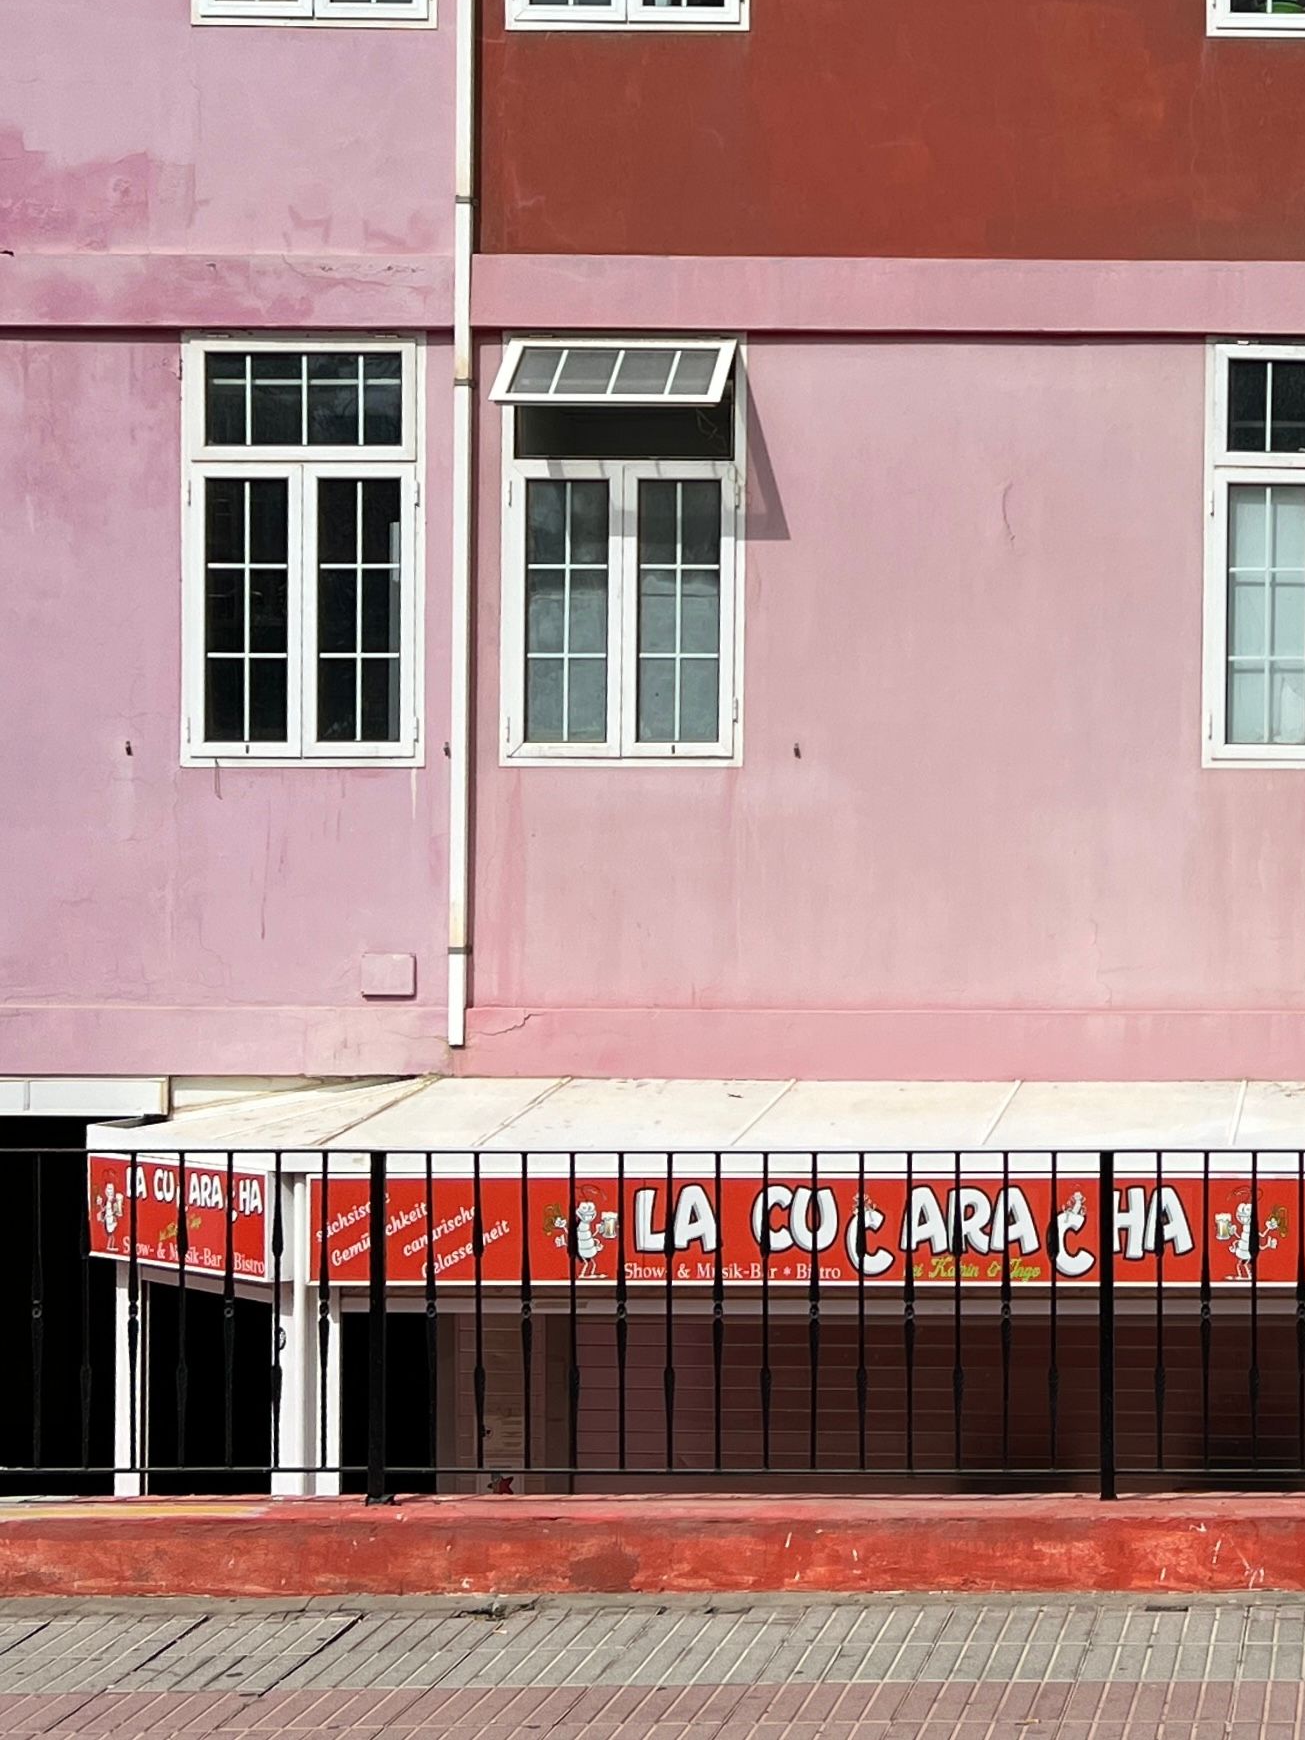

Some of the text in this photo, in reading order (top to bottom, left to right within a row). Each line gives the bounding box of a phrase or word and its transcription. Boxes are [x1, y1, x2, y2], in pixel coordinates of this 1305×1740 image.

[153, 1167, 263, 1222] CUARAHA
[315, 1191, 391, 1243] schsisc
[633, 1182, 720, 1254] LA
[122, 1235, 154, 1256] Sow-
[169, 1242, 223, 1268] Msik-Bar
[232, 1251, 265, 1275] Bistro
[331, 1201, 428, 1267] Gemüchkeit
[421, 1219, 510, 1280] elasseeit
[677, 1263, 690, 1279] &
[696, 1262, 778, 1279] Msik-Br
[796, 1262, 841, 1279] Bitro
